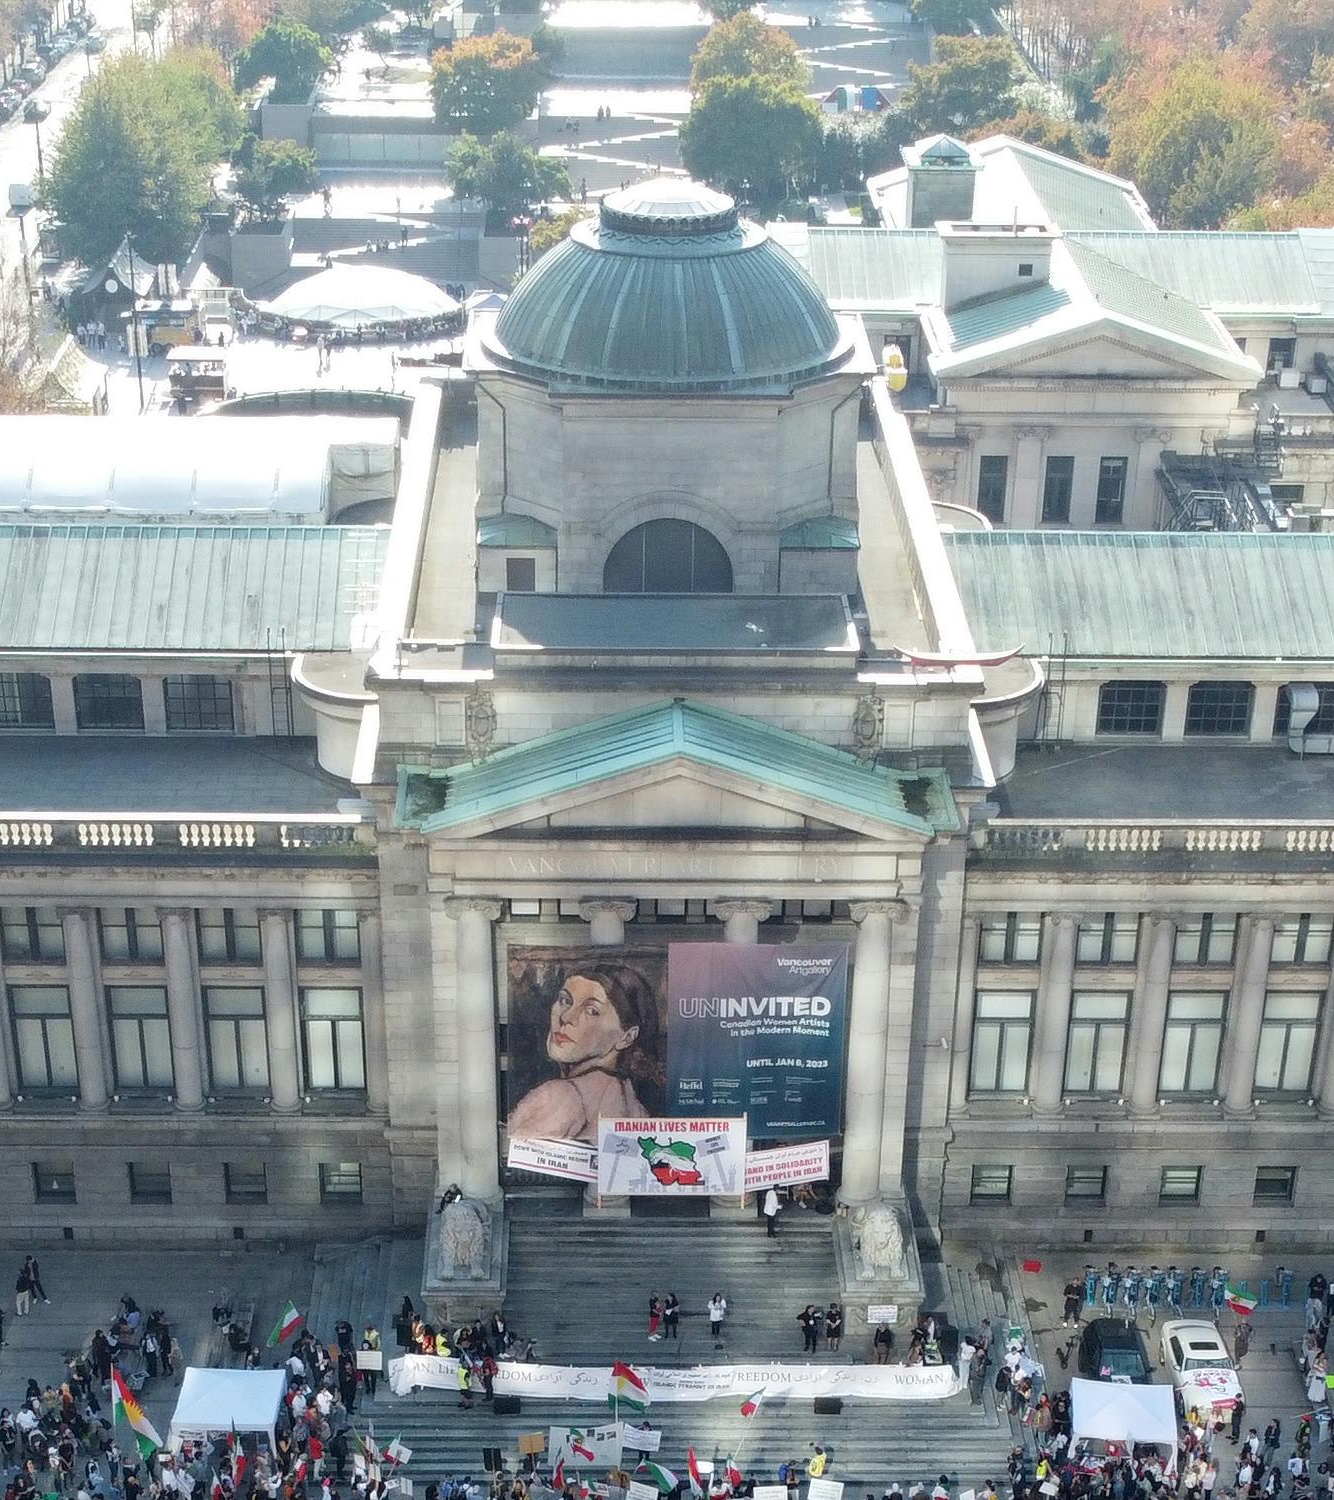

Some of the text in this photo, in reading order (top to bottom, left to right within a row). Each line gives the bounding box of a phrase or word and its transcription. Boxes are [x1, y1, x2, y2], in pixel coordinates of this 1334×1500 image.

[777, 958, 833, 967] Vancouver
[678, 996, 831, 1018] UNINVITED
[720, 1018, 830, 1028] Canadian Women Artists
[741, 1028, 755, 1036] the
[757, 1027, 791, 1035] Modern
[793, 1026, 830, 1037] Moment
[747, 1059, 773, 1068] UNTIL
[775, 1059, 795, 1067] JAN
[806, 1060, 828, 1068] 2023
[615, 1122, 729, 1132] IRANIAN LIVES MATTER
[547, 1159, 568, 1169] IRAN
[746, 1157, 823, 1175] AND IN SOLIDARITY
[763, 1171, 792, 1182] PEOPLE
[793, 1169, 802, 1177] IN
[803, 1166, 823, 1176] IRAN
[737, 1372, 791, 1383] REEDOM
